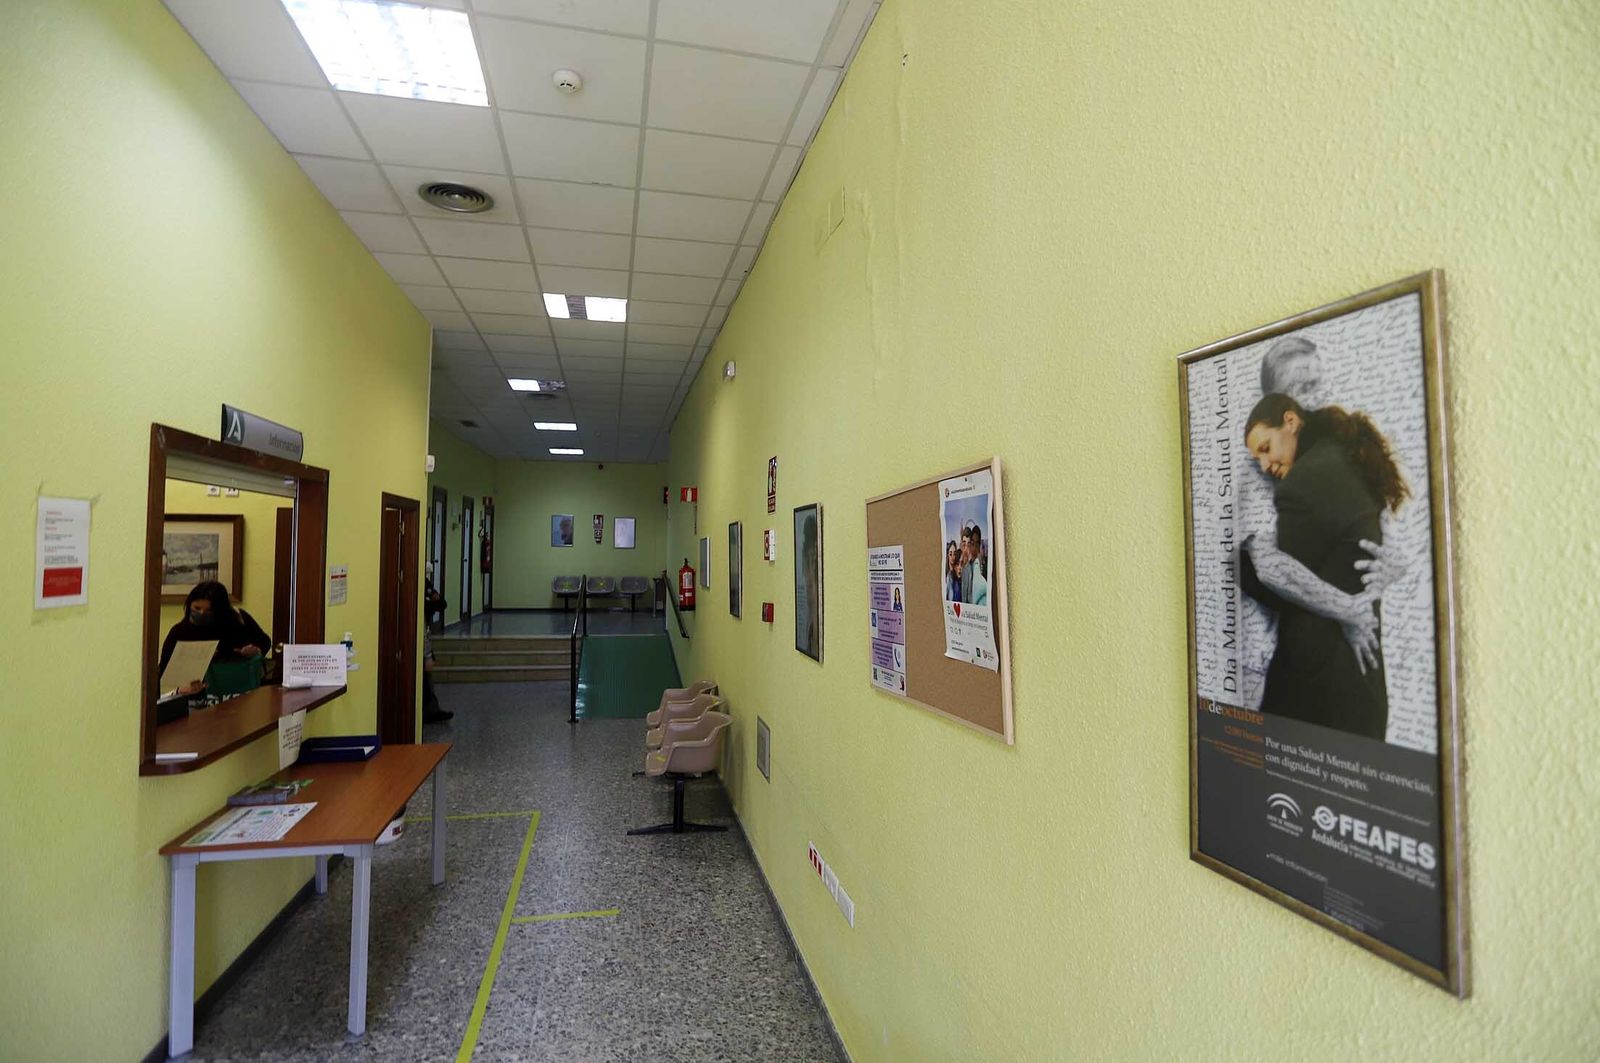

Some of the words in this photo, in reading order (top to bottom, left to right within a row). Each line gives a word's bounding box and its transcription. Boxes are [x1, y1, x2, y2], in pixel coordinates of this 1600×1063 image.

[1215, 357, 1230, 431] Mental
[1217, 437, 1234, 498] Salud
[1219, 503, 1233, 520] la
[1220, 520, 1235, 555] de
[1221, 558, 1237, 652] Mundial
[1223, 657, 1238, 694] Día
[1265, 737, 1280, 750] Por
[1281, 742, 1297, 755] una
[1298, 746, 1324, 762] Salud
[1326, 753, 1360, 773] Mental
[1362, 765, 1378, 778] sin
[1379, 771, 1436, 797] carencias,
[1265, 753, 1280, 764] con
[1281, 756, 1321, 777] dignidad
[1321, 770, 1328, 781] y
[1339, 813, 1437, 870] FEAFES
